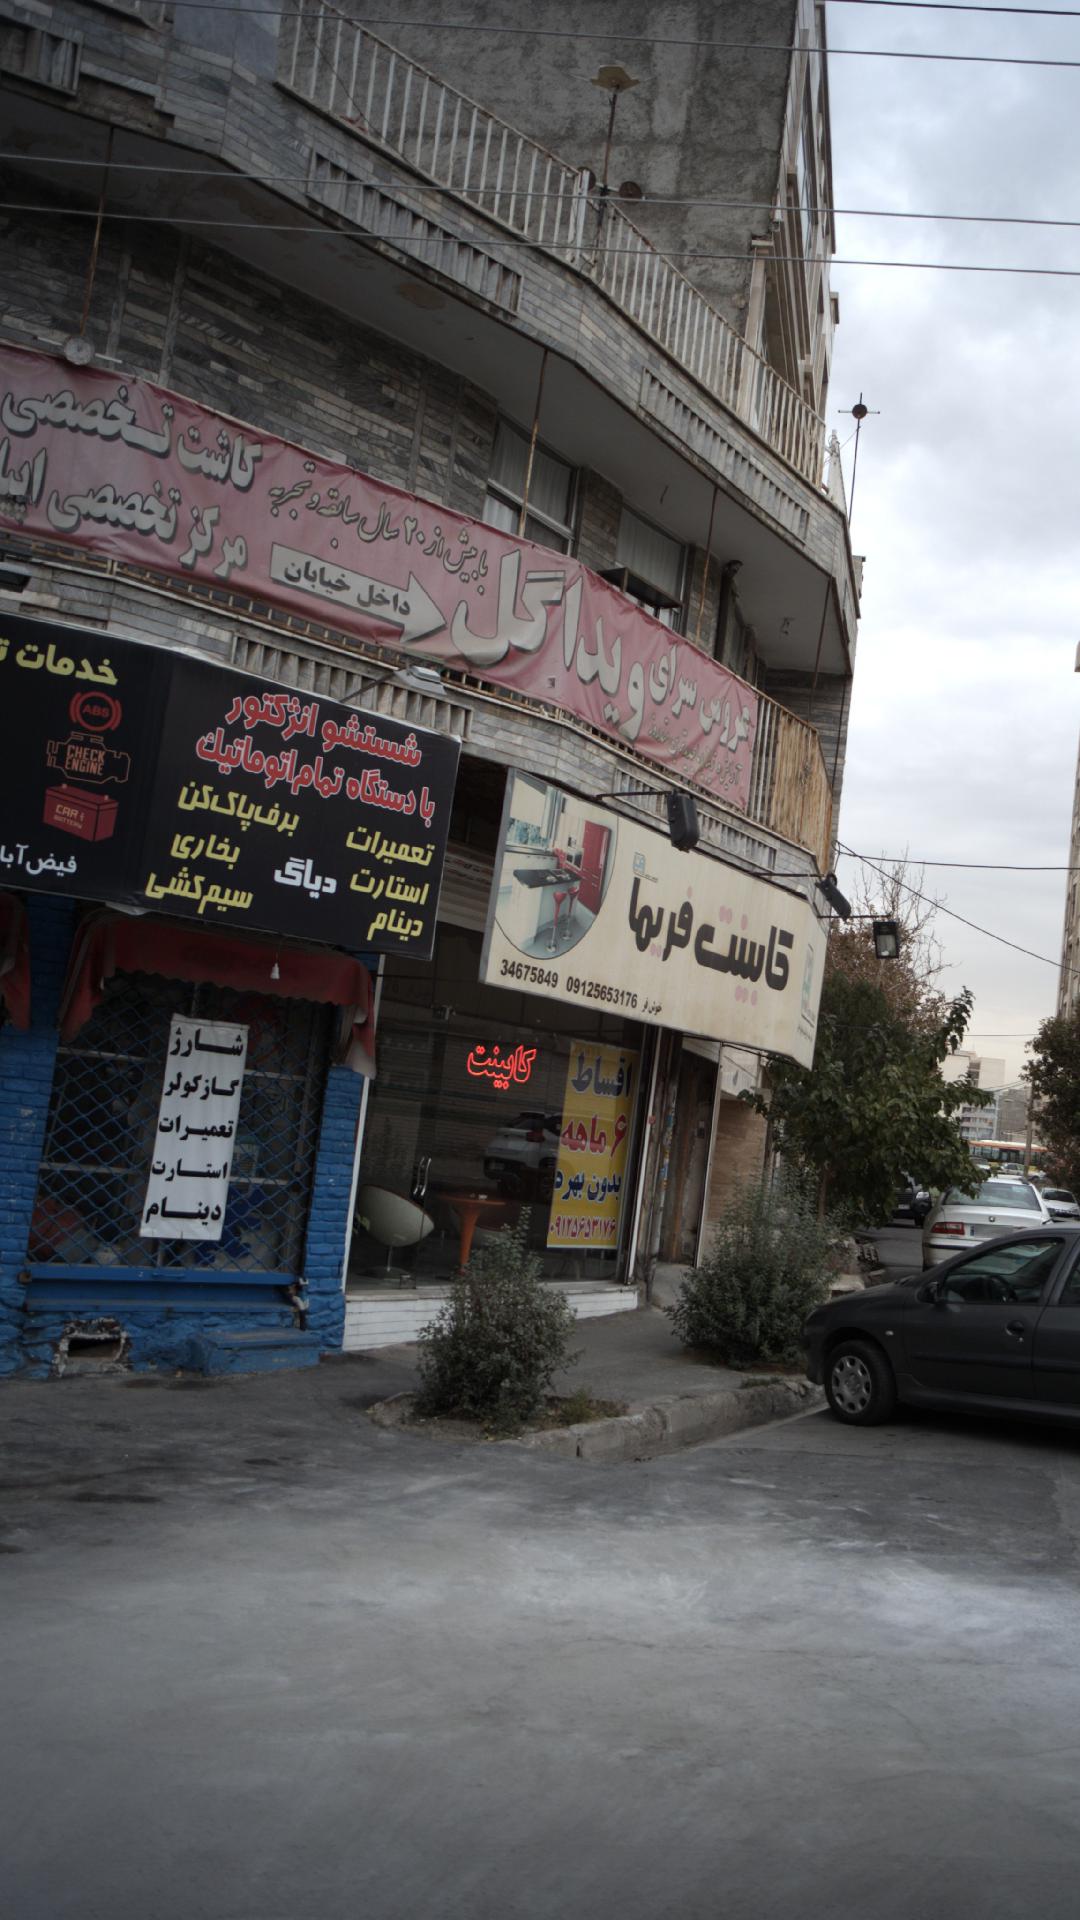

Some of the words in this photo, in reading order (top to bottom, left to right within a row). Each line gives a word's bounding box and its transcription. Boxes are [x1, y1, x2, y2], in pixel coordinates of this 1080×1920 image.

[1, 385, 173, 460] تخصصی
[177, 427, 262, 492] کاشت
[269, 461, 316, 520] تجربه
[306, 493, 320, 510] و
[46, 481, 182, 543] تخصصی
[317, 488, 360, 549] سابقه
[357, 502, 399, 542] سال
[404, 516, 425, 545] ۲۰
[178, 505, 250, 582] مرکز
[423, 526, 445, 558] از
[442, 528, 479, 582] بیش
[284, 560, 351, 594] خیابان
[357, 585, 411, 615] داخل
[16, 644, 119, 686] خدمات
[649, 643, 698, 718] سرای
[225, 692, 319, 741] انژکتور
[699, 698, 752, 752] عروس
[67, 744, 106, 764] CHECK
[321, 714, 422, 767] شستشو
[65, 758, 104, 777] ENGINE
[291, 756, 345, 798] تمام
[55, 804, 79, 819] CAR
[346, 768, 416, 815] دستگاه
[419, 786, 436, 828] با
[26, 853, 77, 877] فیض
[170, 832, 241, 870] بخاری
[345, 826, 436, 867] تعمیرات
[273, 856, 337, 899] دیاگ
[349, 868, 430, 906] استارت
[366, 908, 424, 942] دینام
[694, 906, 795, 1006] کابینت
[500, 958, 559, 989] 34675849
[565, 976, 638, 1009] 09125653176
[170, 1028, 244, 1057] شارژ
[466, 1045, 538, 1090] کابینت
[571, 1052, 632, 1097] اقساط
[159, 1115, 234, 1141] تعمیرات
[561, 1115, 607, 1154] ماهه
[610, 1113, 627, 1157] ۶
[152, 1159, 228, 1181] استارت
[554, 1170, 585, 1200] بهره
[587, 1172, 622, 1202] بدون
[146, 1197, 222, 1225] دینام
